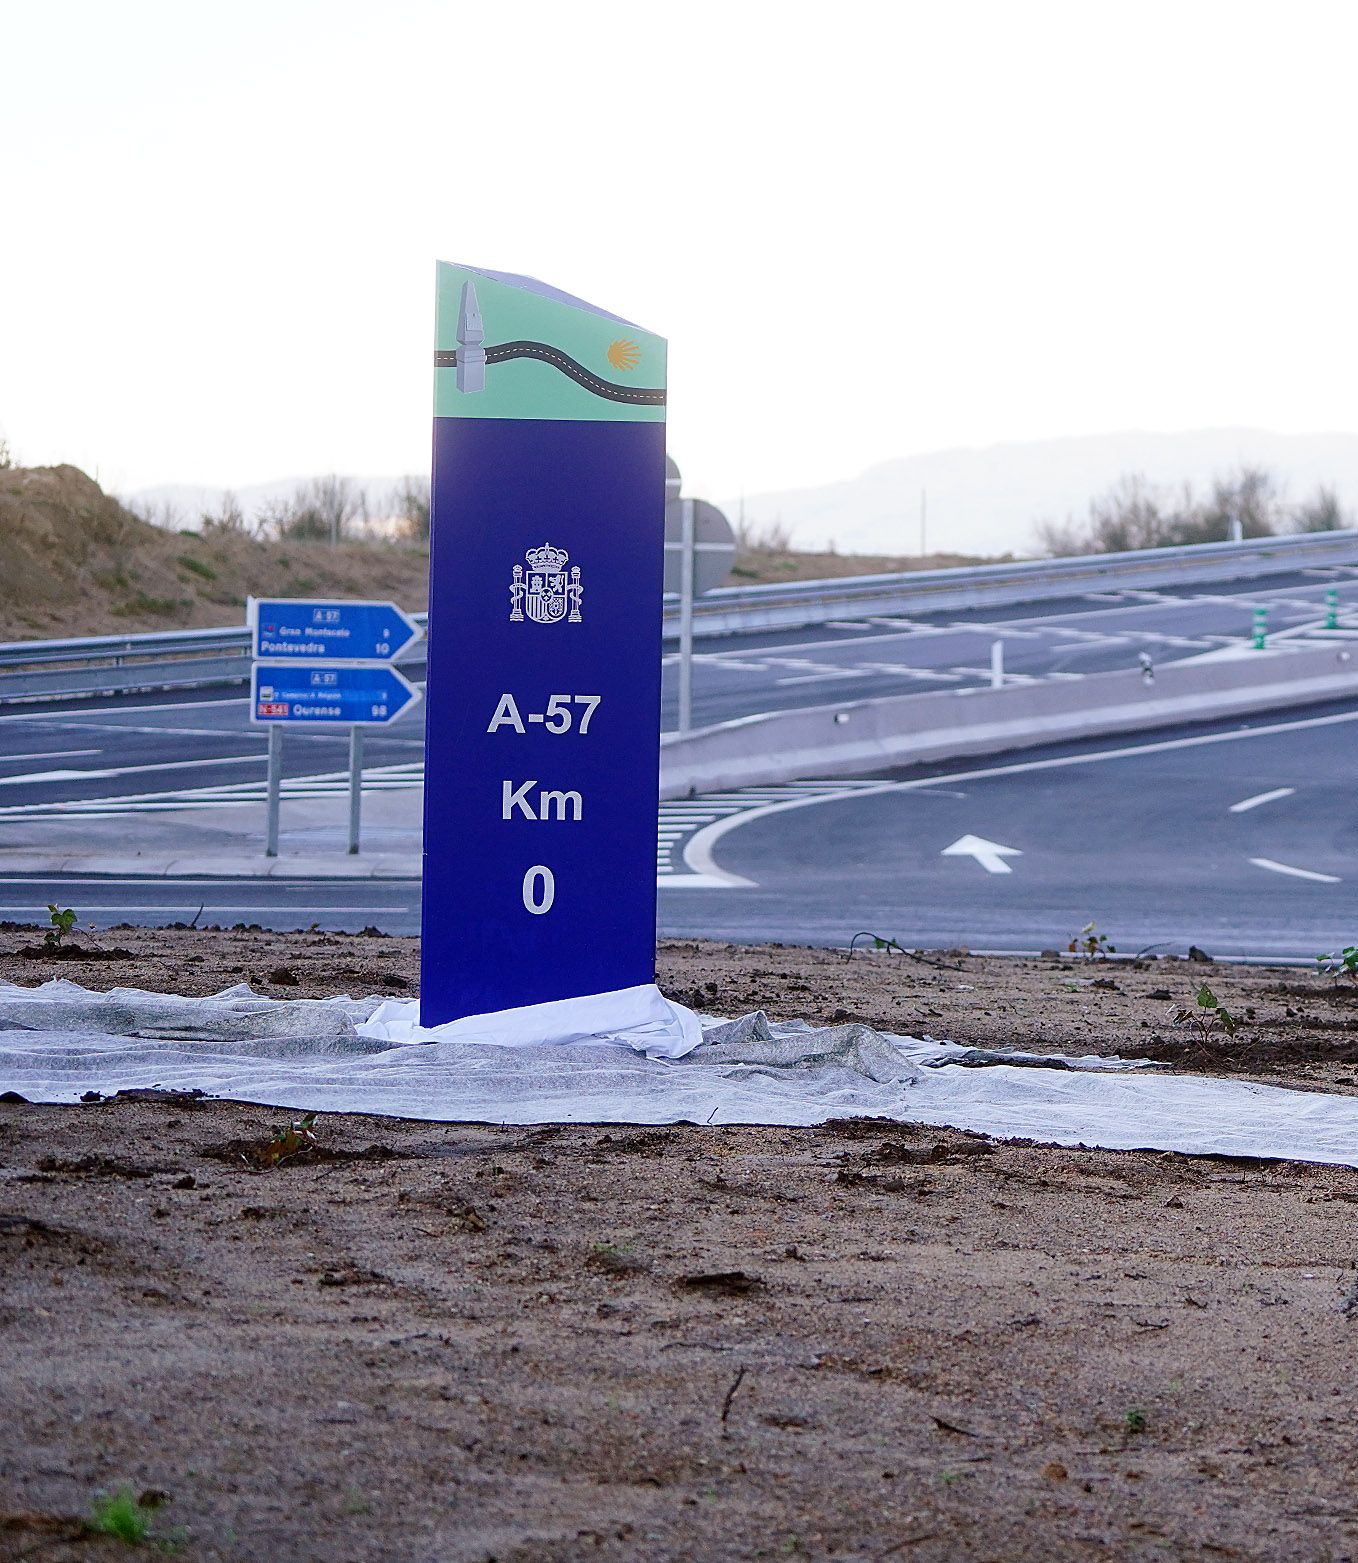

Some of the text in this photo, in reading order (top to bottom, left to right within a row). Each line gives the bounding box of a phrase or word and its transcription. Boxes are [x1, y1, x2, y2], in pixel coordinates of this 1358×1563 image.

[261, 640, 391, 655] Pontevedra 10
[292, 704, 342, 716] Ourense
[487, 693, 601, 734] A-57
[502, 780, 583, 821] Km
[522, 865, 555, 915] 0
